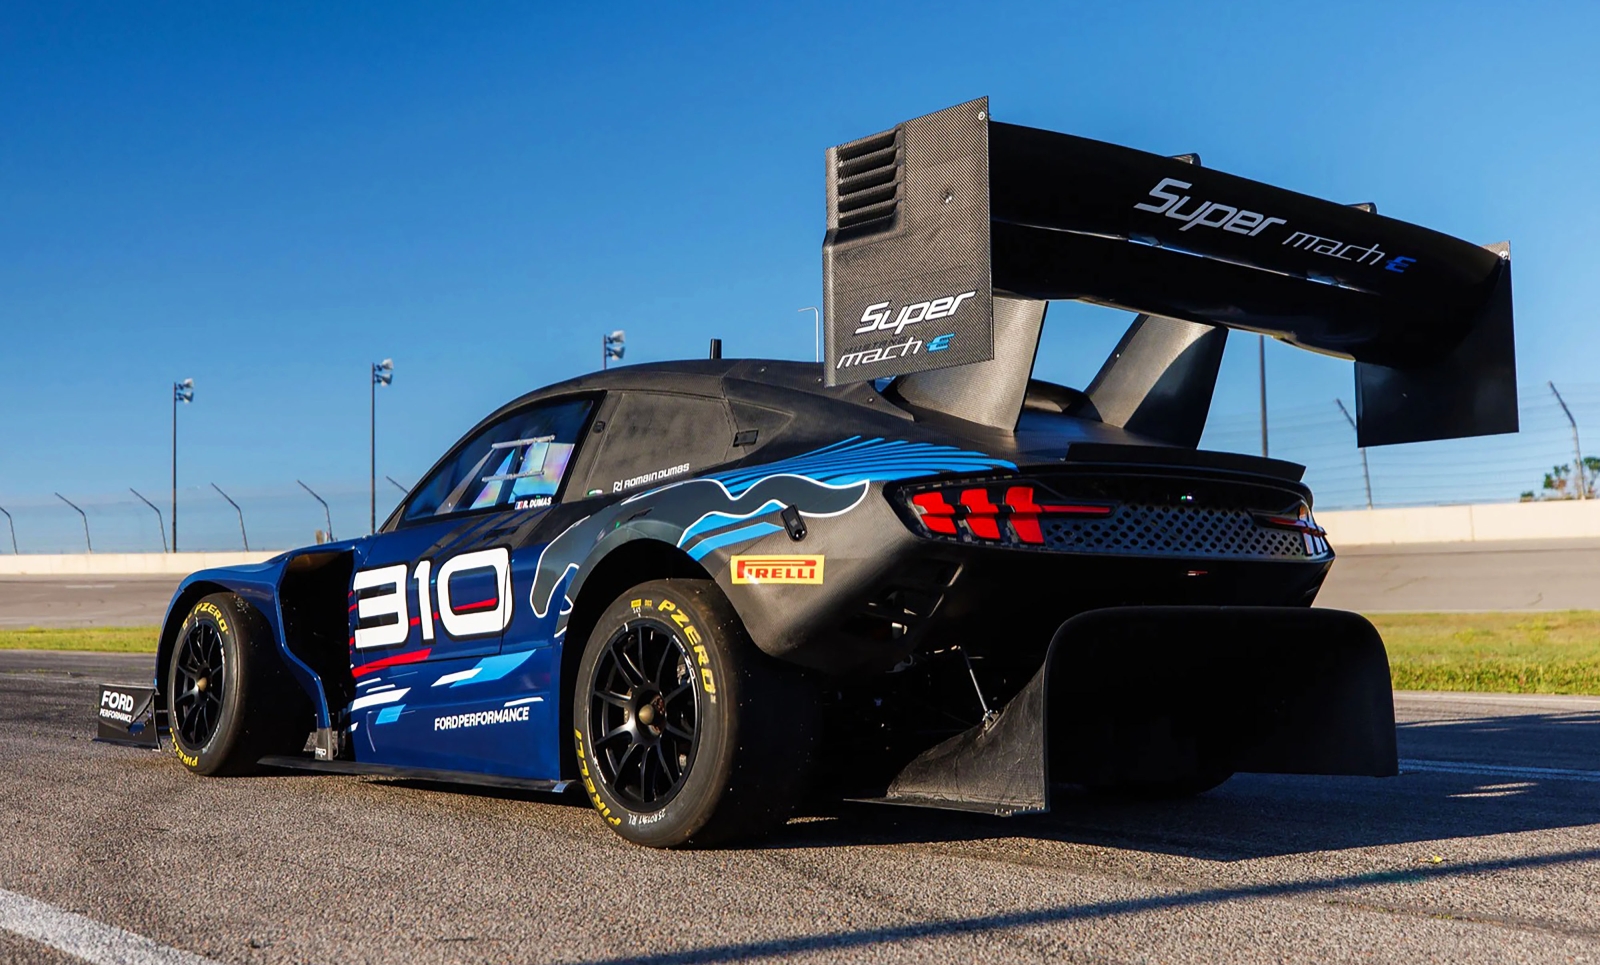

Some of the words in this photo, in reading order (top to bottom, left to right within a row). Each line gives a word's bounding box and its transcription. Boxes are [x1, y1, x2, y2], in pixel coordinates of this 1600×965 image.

[1133, 177, 1288, 238] Super
[1282, 230, 1386, 266] mach
[854, 289, 977, 336] Super
[836, 336, 923, 370] mach
[529, 496, 553, 509] DUMAS
[737, 559, 817, 580] PIRELLI
[351, 547, 512, 650] 310
[99, 708, 133, 724] PERFORMANCE
[100, 690, 134, 712] FORD
[573, 728, 623, 827] PIRELLI
